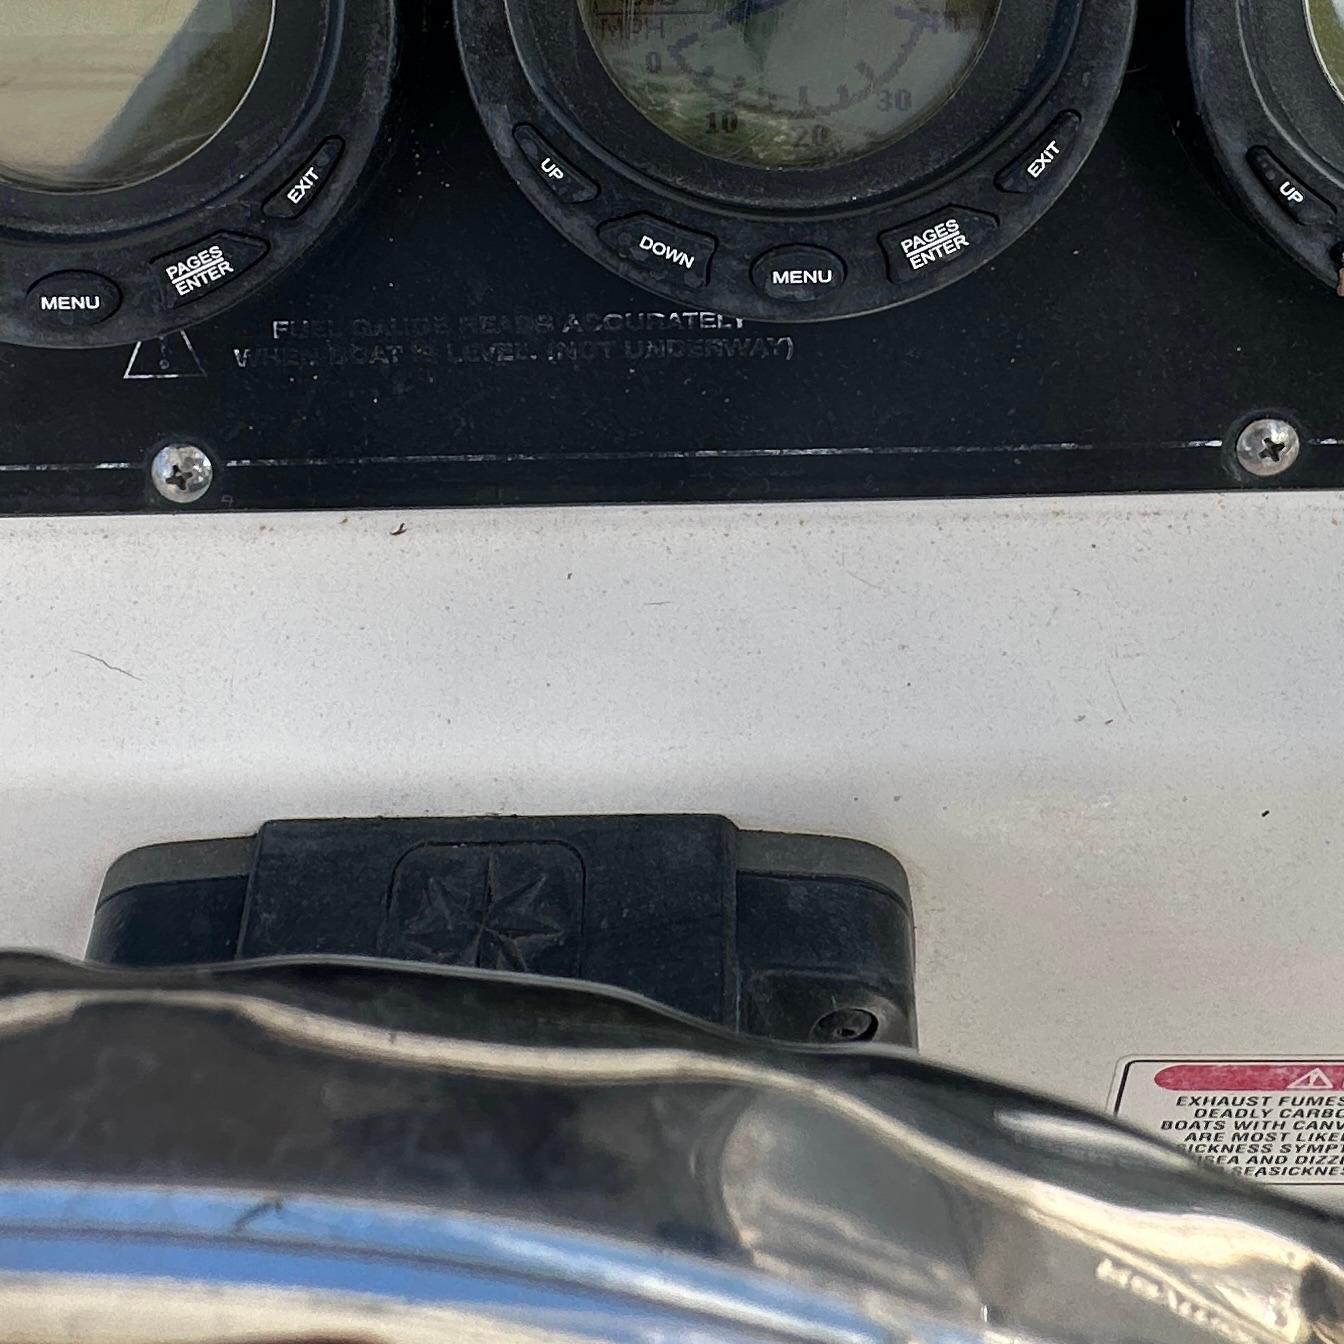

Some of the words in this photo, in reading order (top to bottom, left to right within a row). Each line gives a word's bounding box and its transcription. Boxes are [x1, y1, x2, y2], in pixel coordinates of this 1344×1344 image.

[540, 157, 565, 181] UP
[1027, 140, 1060, 178] EXIT
[286, 167, 319, 204] EXIT
[1279, 181, 1304, 204] UP
[900, 218, 960, 254] PAGES
[165, 245, 224, 281] PAGES
[639, 235, 695, 269] DOWN
[909, 234, 970, 270] ENTER
[175, 261, 234, 296] ENTER
[772, 269, 832, 284] MENU
[40, 296, 100, 310] MENU
[1176, 1096, 1273, 1107] EXHAUST
[1194, 1108, 1274, 1119] DEADLY
[1161, 1120, 1226, 1131] BOATS
[1234, 1120, 1287, 1131] WITH
[1184, 1132, 1226, 1142] ARE
[1232, 1132, 1290, 1142] MOST
[1246, 1155, 1289, 1166] AND
